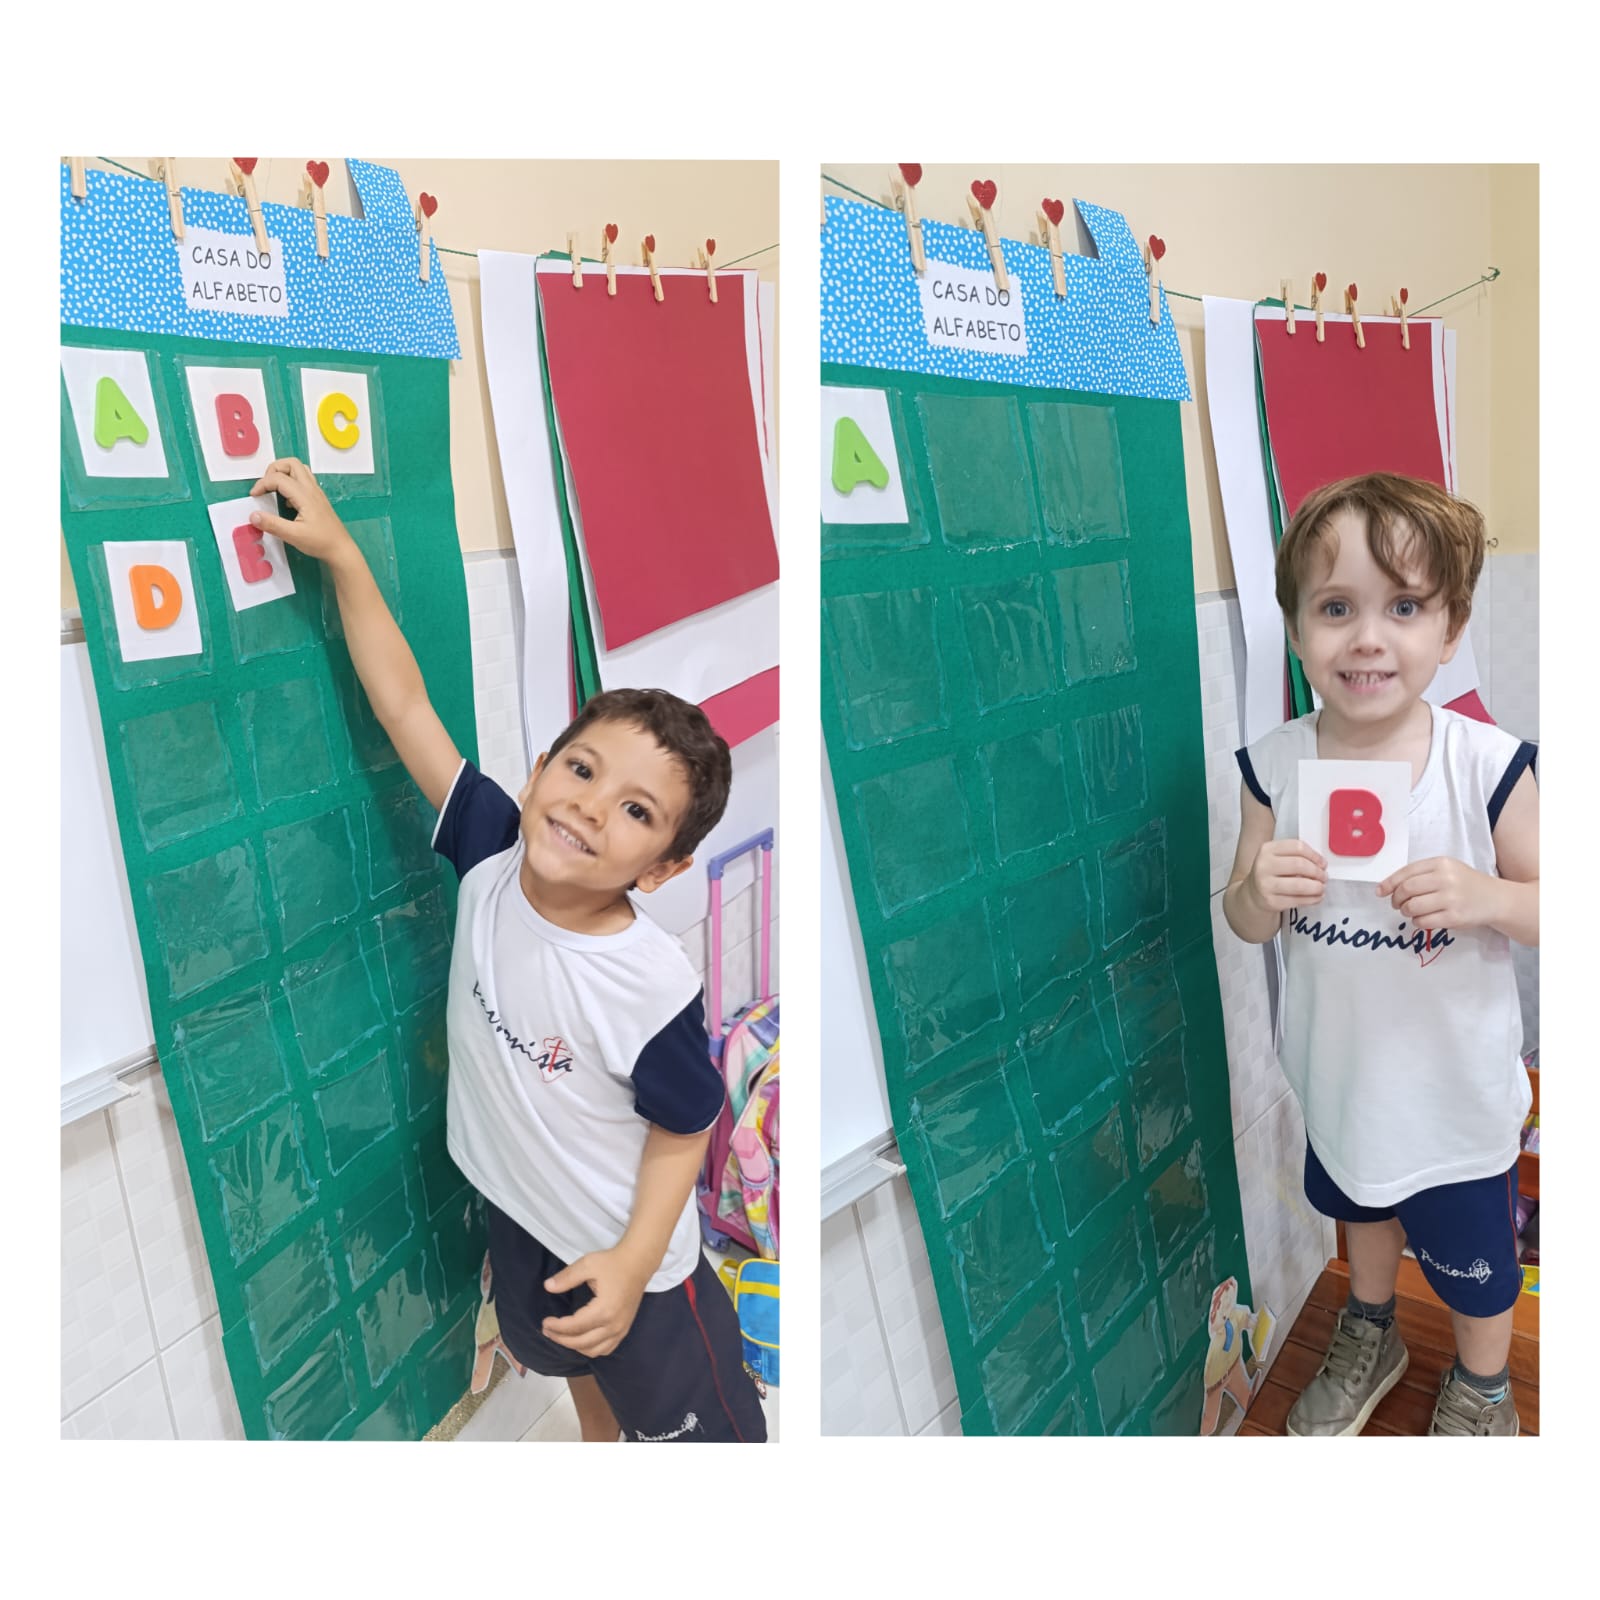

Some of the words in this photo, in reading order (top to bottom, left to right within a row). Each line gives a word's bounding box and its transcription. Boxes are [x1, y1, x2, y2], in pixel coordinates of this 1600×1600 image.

[192, 246, 240, 267] CASA
[246, 250, 271, 270] DO
[192, 281, 282, 304] ALFABETO
[933, 280, 979, 304] CASA
[985, 287, 1010, 307] DO
[933, 317, 1021, 343] ALFABETO
[95, 377, 149, 448] A
[215, 393, 260, 457] B
[317, 392, 360, 449] C
[831, 416, 889, 493] A
[232, 522, 274, 584] E
[129, 564, 183, 630] D
[1328, 788, 1386, 857] B
